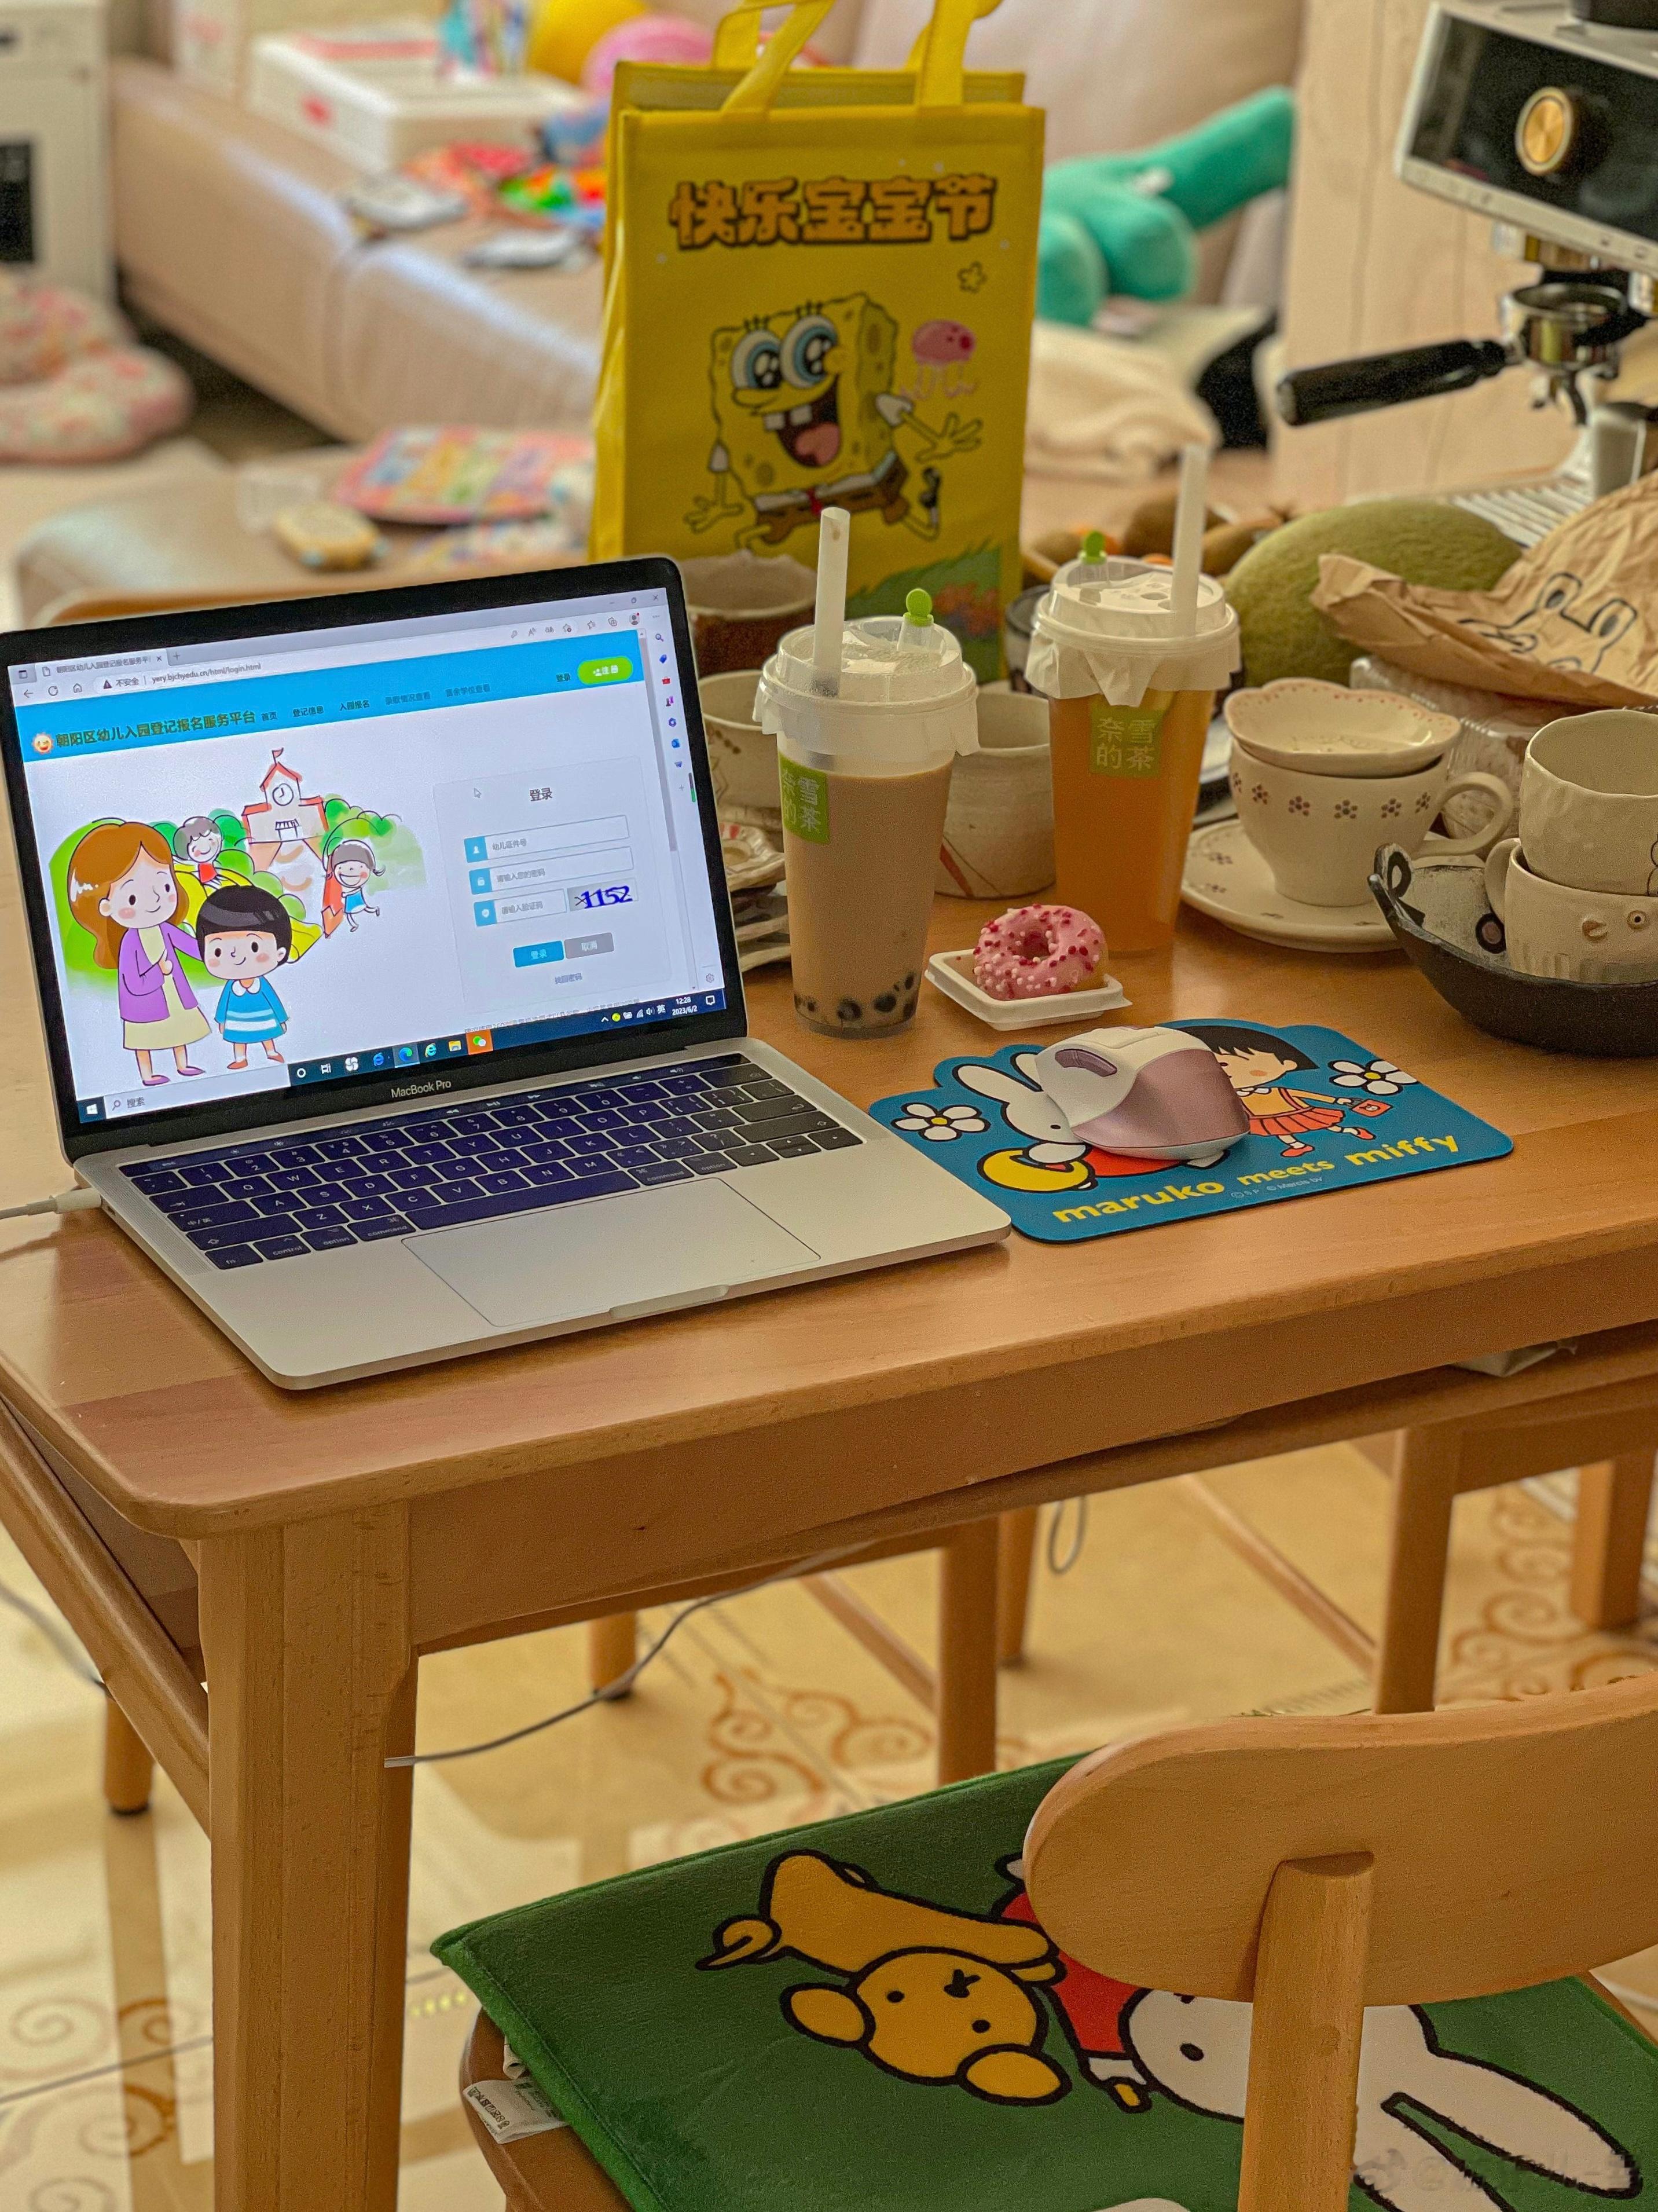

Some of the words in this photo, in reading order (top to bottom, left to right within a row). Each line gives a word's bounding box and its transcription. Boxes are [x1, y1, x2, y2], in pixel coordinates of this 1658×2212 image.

[668, 174, 997, 251] 快乐宝宝节
[116, 677, 140, 687] 不安全
[292, 705, 325, 718] 登记信息
[339, 700, 371, 712] 入园报名
[261, 711, 278, 722] 首页
[56, 710, 256, 748] 朝阳区幼儿入园登记报名服务平台
[529, 787, 553, 802] 登录
[580, 885, 633, 910] 1152
[656, 1004, 666, 1015] 英
[672, 1005, 698, 1016] 2023/6/2
[390, 1082, 435, 1098] MacBook
[435, 1080, 452, 1090] Pro
[127, 1097, 145, 1109] 搜索
[1052, 1181, 1225, 1222] maruko
[1236, 1160, 1335, 1186] meets
[1344, 1135, 1459, 1166] miffy
